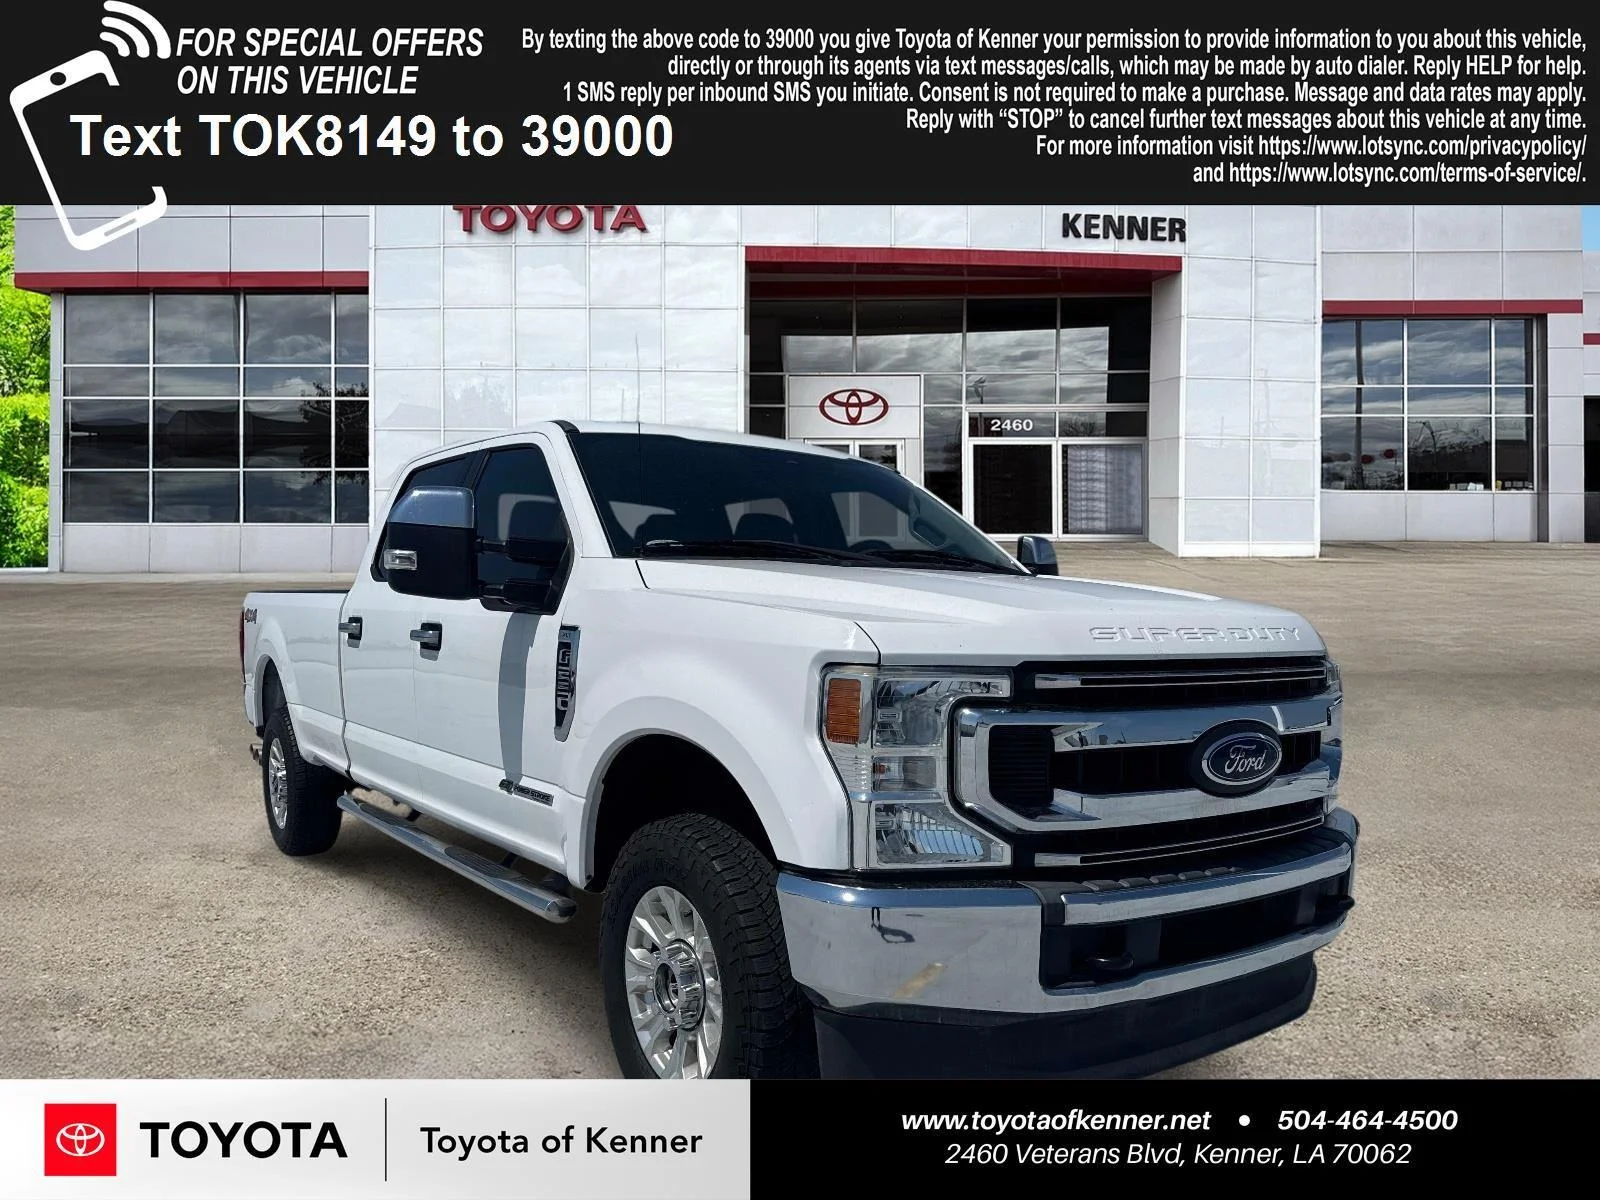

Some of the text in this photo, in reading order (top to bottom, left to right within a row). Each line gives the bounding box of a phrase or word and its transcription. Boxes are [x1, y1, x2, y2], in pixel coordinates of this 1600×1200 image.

[453, 205, 647, 232] TOYOTA
[1062, 213, 1186, 242] KENNER
[990, 419, 1033, 431] 2460
[1088, 626, 1300, 642] SUPER DUTY
[1224, 745, 1268, 774] Ford
